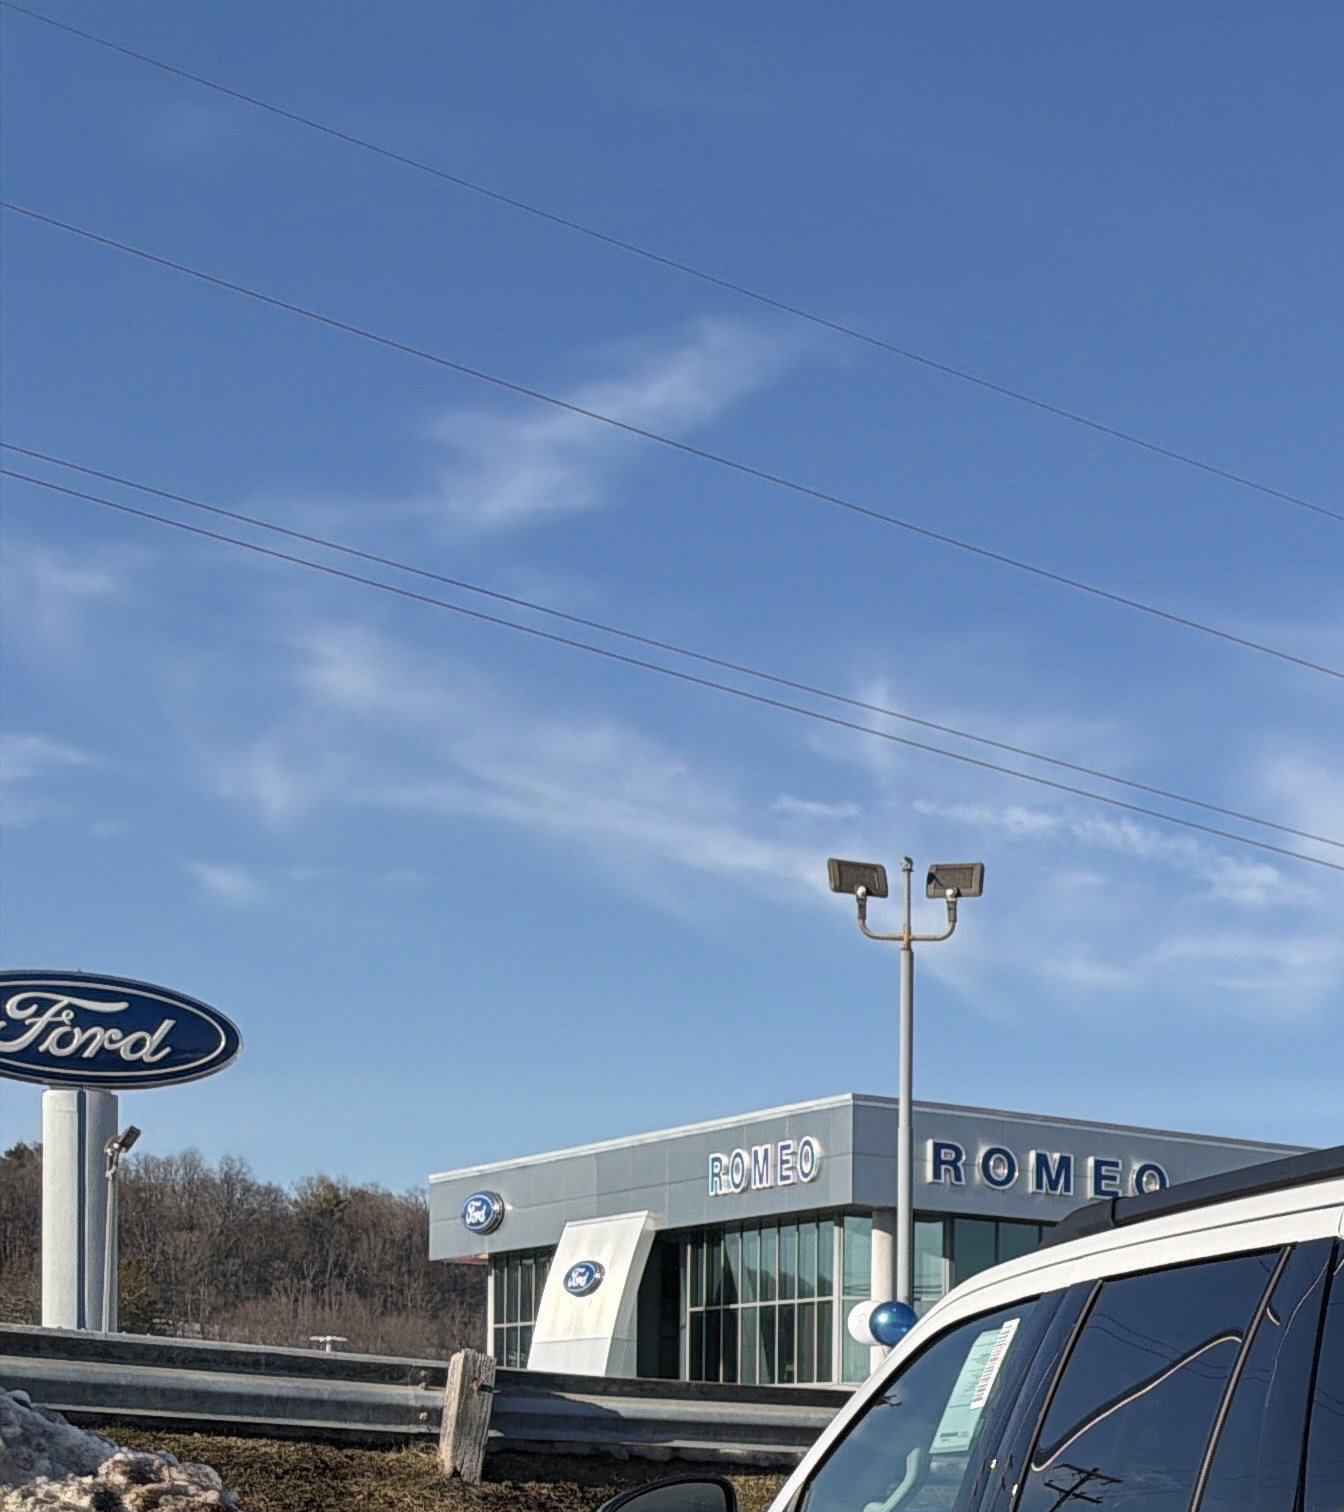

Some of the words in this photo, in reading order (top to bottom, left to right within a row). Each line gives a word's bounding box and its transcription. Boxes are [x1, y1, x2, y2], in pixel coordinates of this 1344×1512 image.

[0, 991, 177, 1063] Ford
[708, 1135, 821, 1197] ROMEO
[925, 1138, 1171, 1200] ROMEO
